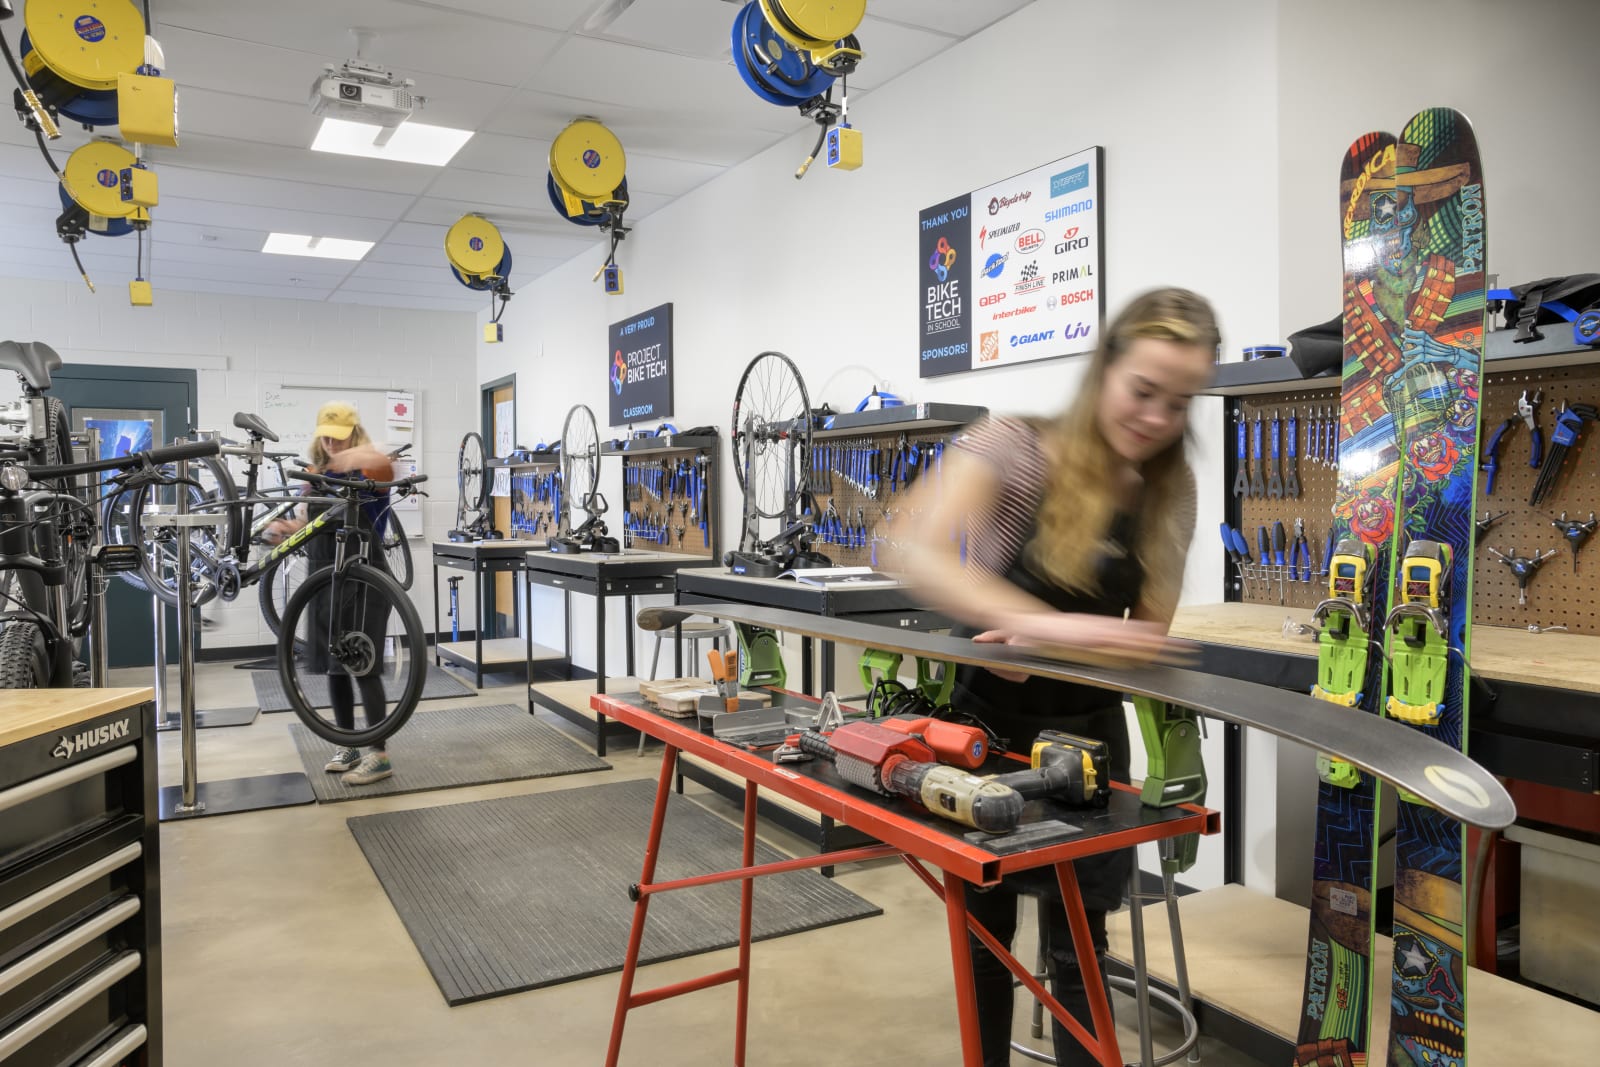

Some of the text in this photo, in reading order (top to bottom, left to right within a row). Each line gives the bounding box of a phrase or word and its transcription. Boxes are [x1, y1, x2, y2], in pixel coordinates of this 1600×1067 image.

[921, 205, 969, 231] THANK YOU
[1044, 199, 1093, 223] SHIMANO
[988, 222, 1021, 240] SPECIALIZED
[1018, 232, 1042, 249] BELL
[1054, 236, 1090, 255] GIRO
[1052, 264, 1093, 285] PRIMAL
[927, 280, 959, 304] BIKE
[1014, 279, 1045, 292] FINISH LINE
[979, 292, 1007, 308] QBP
[1061, 288, 1094, 306] BOSCH
[925, 297, 961, 321] TECH
[992, 305, 1037, 321] interbike
[624, 322, 637, 336] VERY
[637, 316, 655, 333] PROUD
[927, 318, 960, 333] IN SCHOOL
[1018, 330, 1055, 345] GIANT
[627, 343, 662, 368] PROJECT
[921, 342, 969, 361] SPONSORS!
[627, 359, 667, 384] BIKE TECH
[623, 403, 653, 418] CLASSROOM
[258, 511, 326, 570] TREK
[75, 718, 129, 753] HUSKY
